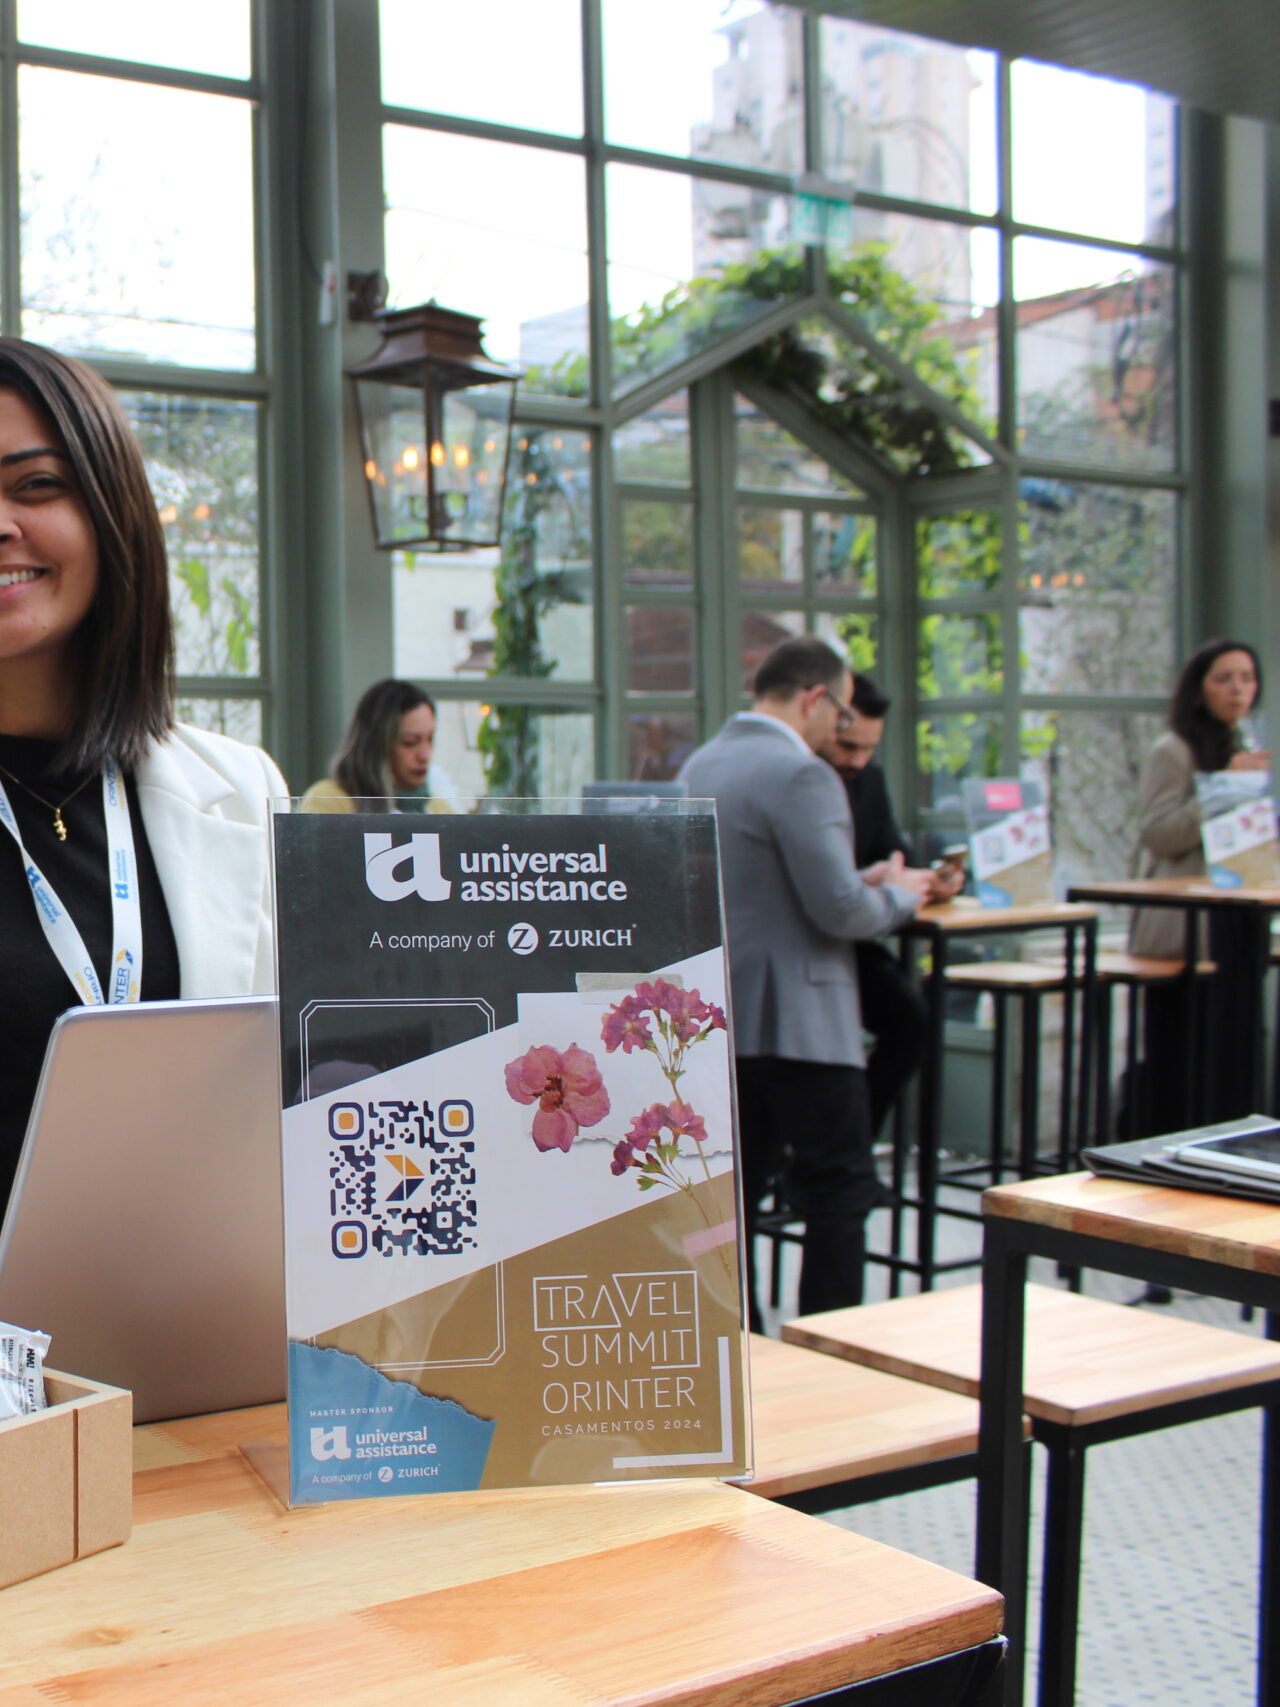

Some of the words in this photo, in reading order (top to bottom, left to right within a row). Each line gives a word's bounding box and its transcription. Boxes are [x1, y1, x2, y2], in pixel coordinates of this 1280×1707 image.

[459, 843, 608, 874] universal
[460, 872, 628, 902] assistance
[369, 931, 384, 949] A
[388, 933, 473, 952] company
[477, 930, 496, 948] of
[548, 928, 632, 948] ZURICH
[539, 1281, 692, 1321] TRAVEL
[541, 1329, 693, 1368] SUMMIT
[542, 1376, 696, 1414] ORINTER
[309, 1408, 346, 1417] MASTER
[350, 1405, 394, 1415] SPONSOR
[355, 1425, 428, 1445] universal
[541, 1420, 656, 1436] CASAMENTOS
[663, 1419, 702, 1430] 2024
[355, 1442, 438, 1459] assistance
[312, 1474, 320, 1484] A
[320, 1472, 362, 1484] company
[363, 1471, 372, 1480] of
[398, 1466, 439, 1478] ZURICH
